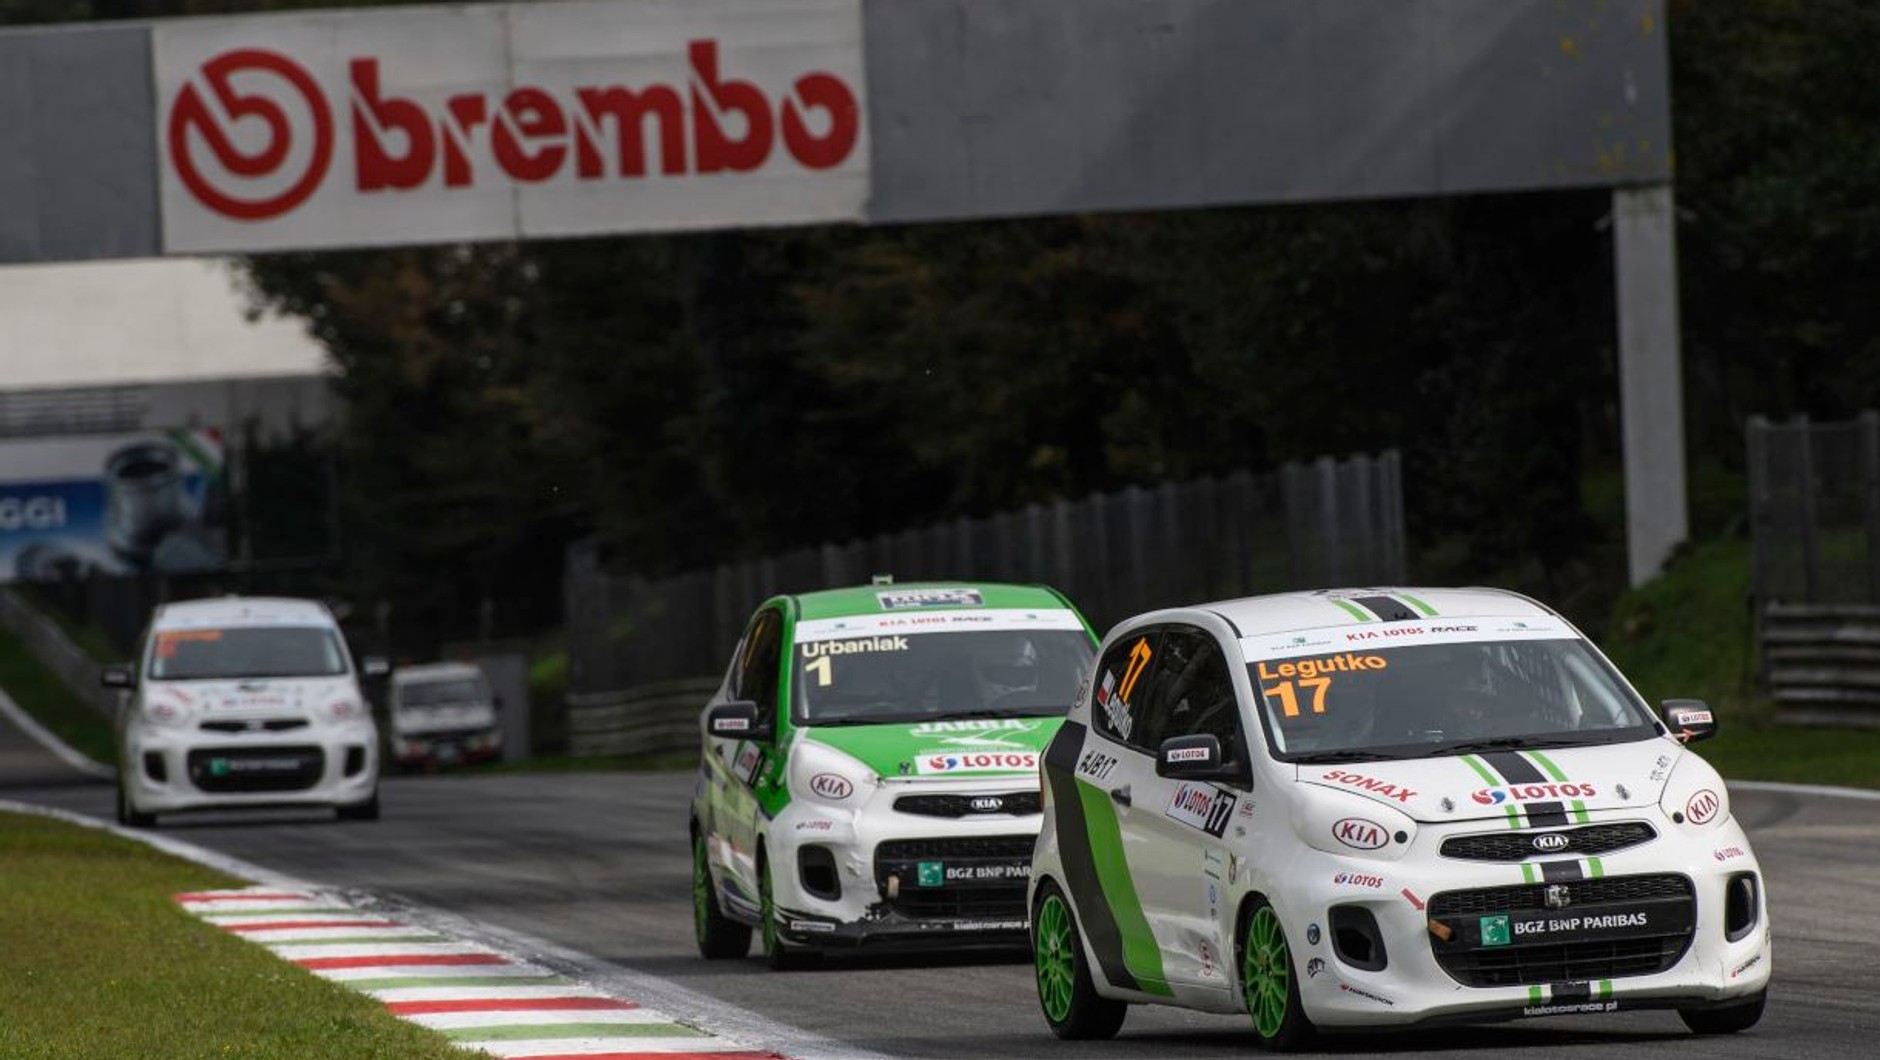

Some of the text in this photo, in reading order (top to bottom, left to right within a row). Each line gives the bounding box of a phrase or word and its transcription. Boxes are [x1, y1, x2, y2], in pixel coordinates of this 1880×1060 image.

[350, 38, 860, 193] brembo
[1346, 624, 1479, 642] KIA LOTOS RACE
[801, 635, 908, 658] Urbaniak
[804, 656, 834, 687] 1
[1119, 637, 1152, 704] 17
[1258, 653, 1387, 680] Legutko
[1264, 677, 1332, 718] 17
[963, 754, 1035, 767] LOTOS
[1181, 749, 1206, 759] LOTOS
[1323, 769, 1418, 803] SONAX
[1509, 783, 1597, 800] LOTOS
[1208, 793, 1234, 832] 17
[1341, 821, 1379, 846] KIA
[946, 866, 973, 880] BGZ
[976, 865, 1004, 879] BNP
[1348, 874, 1384, 888] LOTOS
[1513, 912, 1648, 936] BGZ BNP PARIBAS
